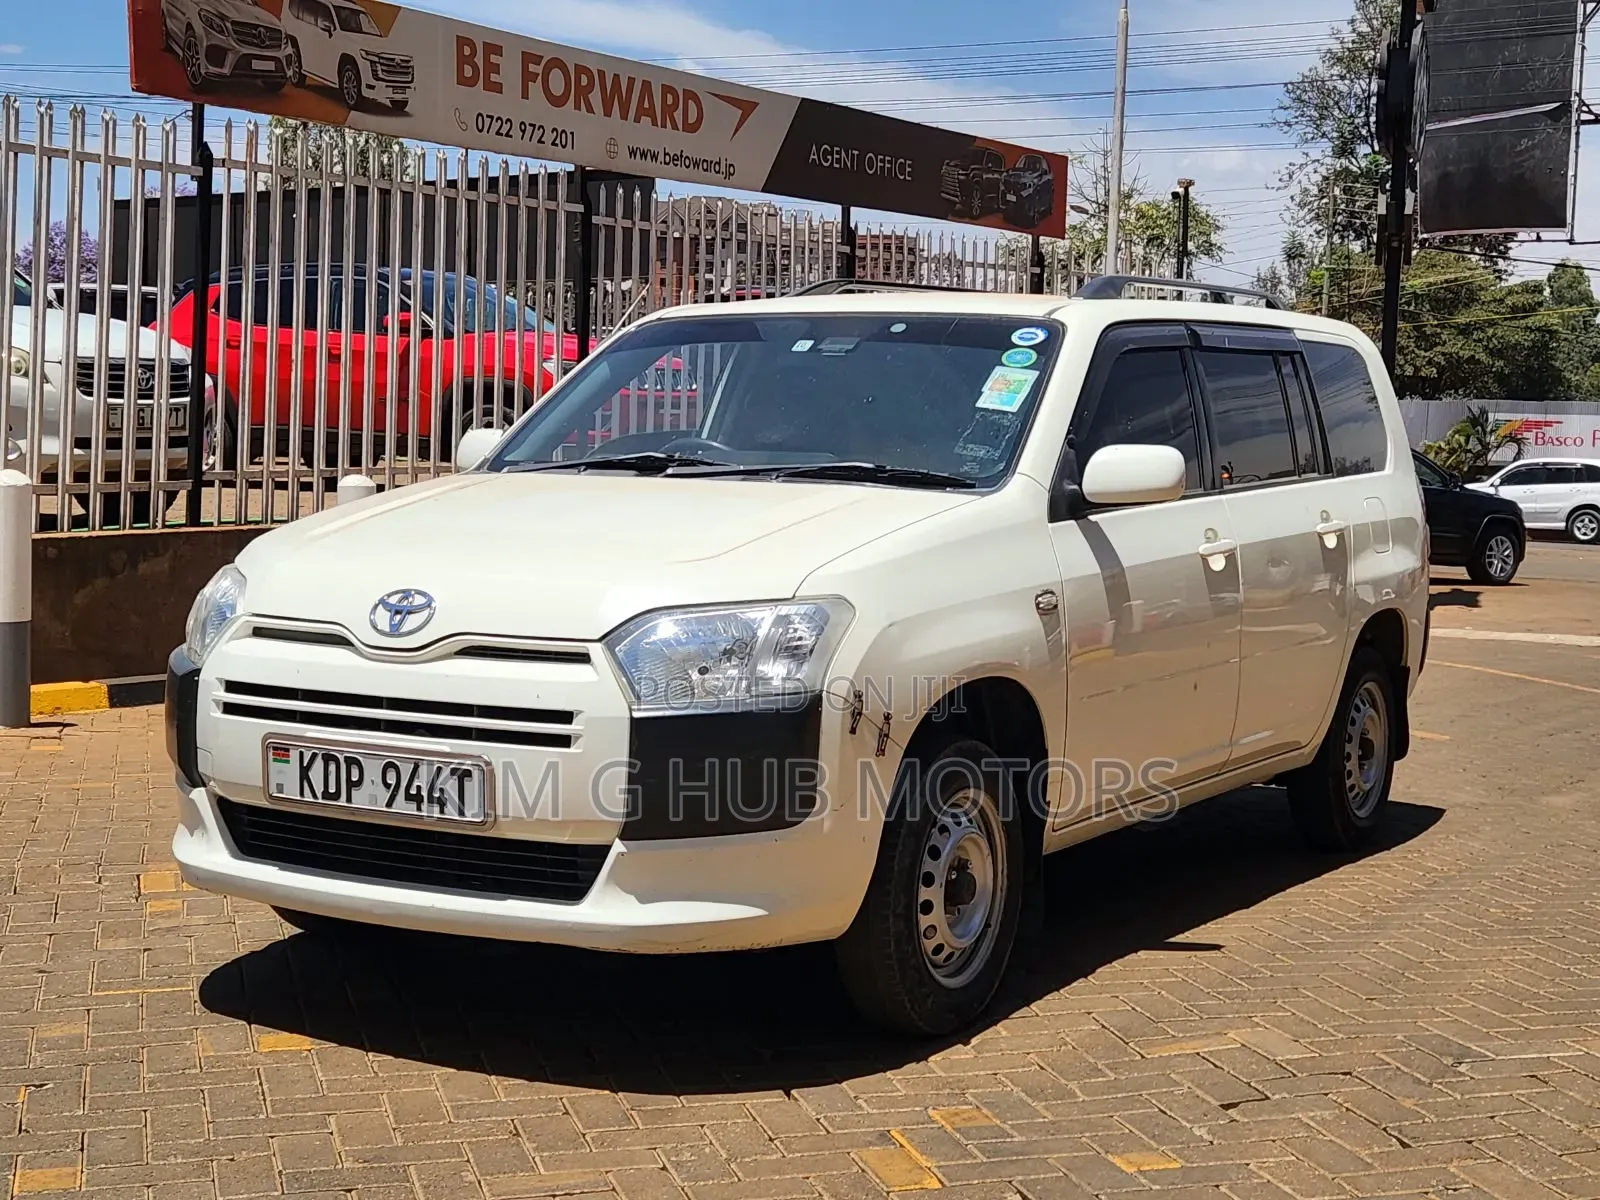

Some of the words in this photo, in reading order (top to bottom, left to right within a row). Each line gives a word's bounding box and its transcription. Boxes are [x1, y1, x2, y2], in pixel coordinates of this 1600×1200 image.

[455, 34, 504, 95] BE
[521, 50, 704, 135] FORWARD
[475, 112, 513, 139] 0722
[519, 120, 546, 144] 972
[550, 127, 576, 151] 201
[627, 143, 736, 181] www.befoward.jp
[808, 144, 860, 171] AGENT
[865, 152, 912, 181] OFFICE
[298, 749, 365, 804] KDP
[381, 759, 473, 818] 944T
